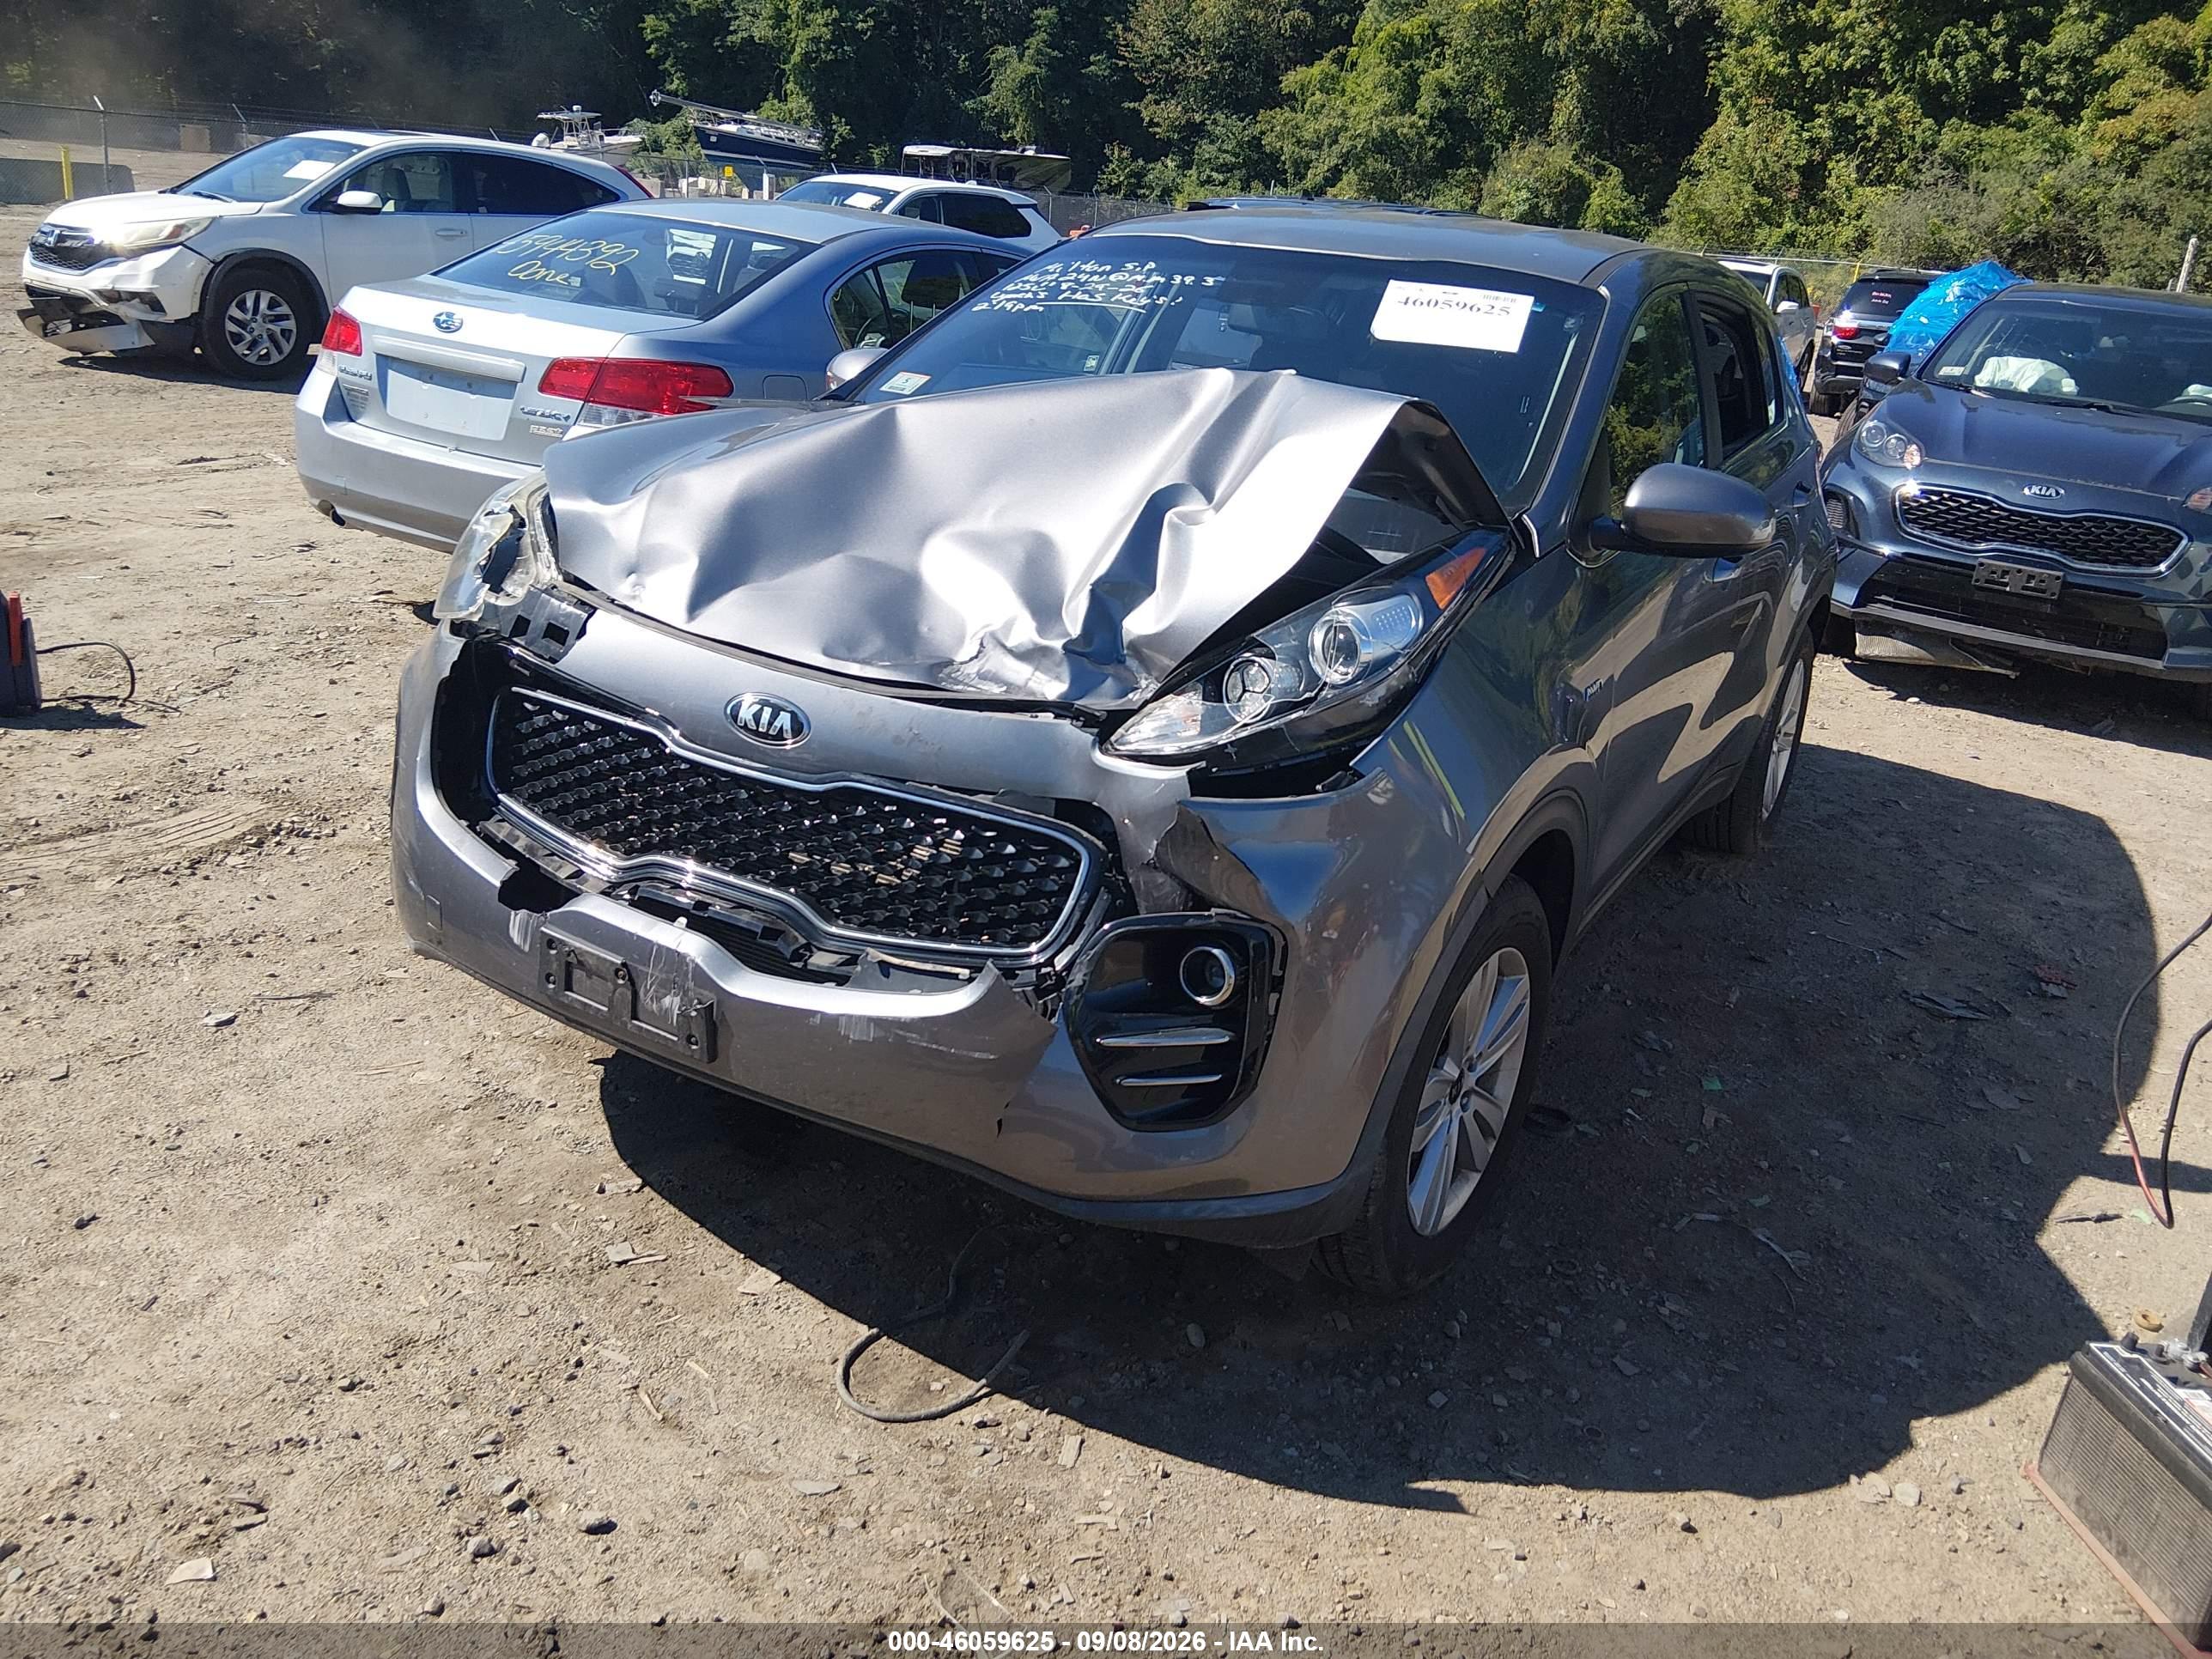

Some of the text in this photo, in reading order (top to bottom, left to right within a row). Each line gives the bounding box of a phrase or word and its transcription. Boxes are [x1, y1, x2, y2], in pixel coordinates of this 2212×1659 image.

[1397, 296, 1512, 317] 46059625
[2030, 484, 2057, 497] KIA
[737, 698, 793, 738] KIA
